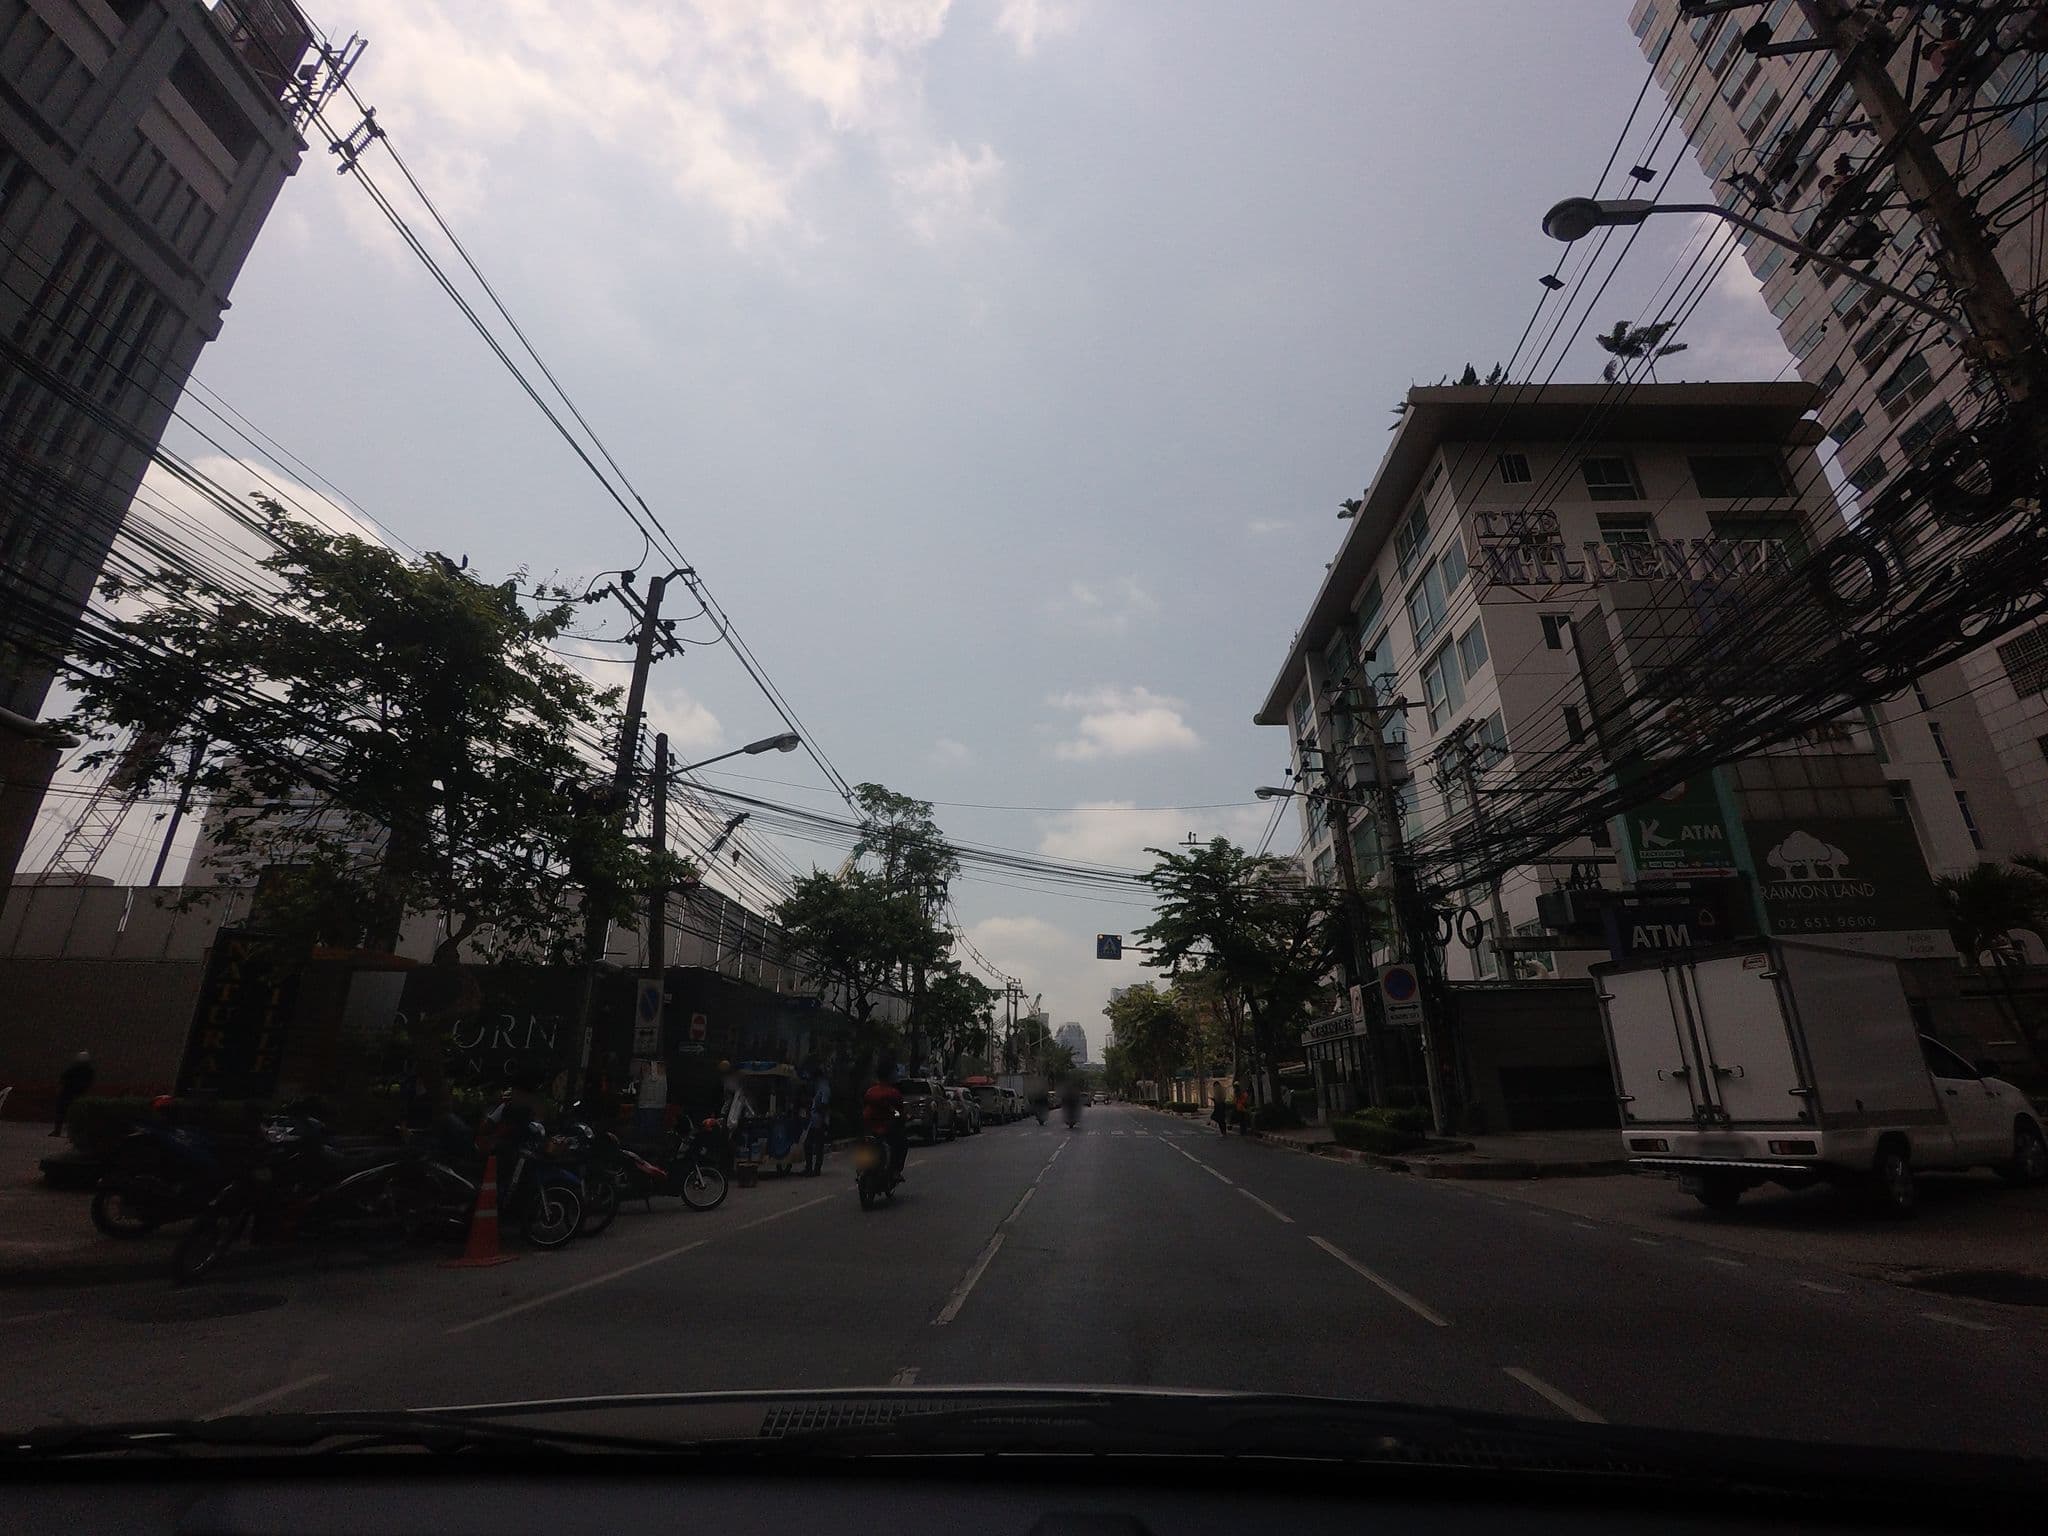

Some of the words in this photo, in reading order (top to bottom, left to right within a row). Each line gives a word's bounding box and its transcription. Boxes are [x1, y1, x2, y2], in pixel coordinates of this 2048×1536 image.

[1475, 510, 1561, 537] THE
[1480, 540, 1793, 583] MILLENNIA
[1680, 824, 1723, 842] ATM
[1760, 883, 1830, 901] RAIMON
[1833, 881, 1876, 898] LAND
[1631, 923, 1692, 950] ATM
